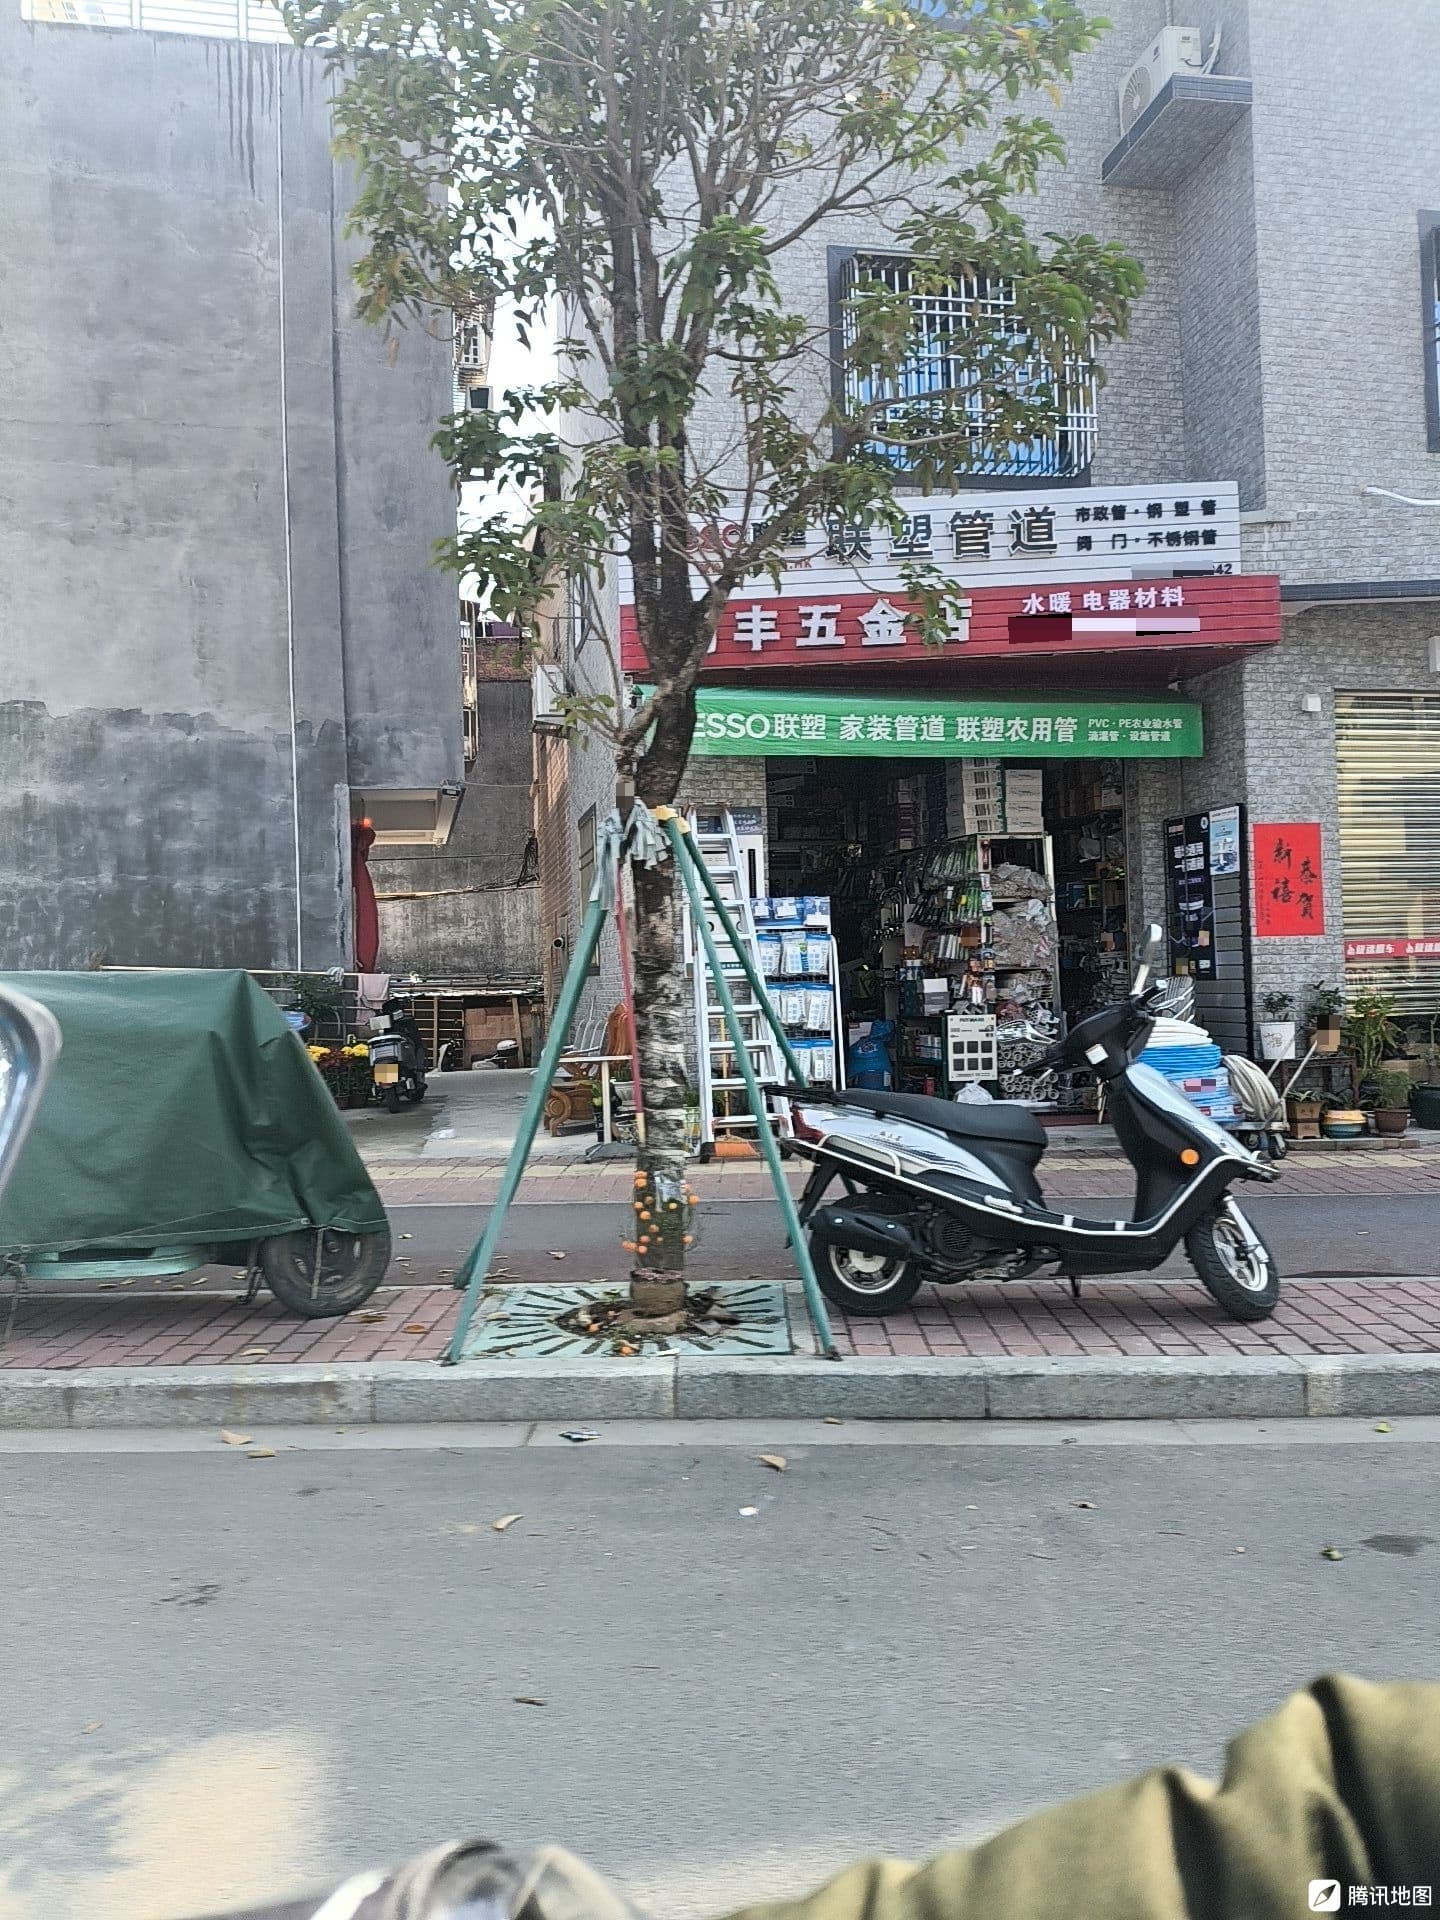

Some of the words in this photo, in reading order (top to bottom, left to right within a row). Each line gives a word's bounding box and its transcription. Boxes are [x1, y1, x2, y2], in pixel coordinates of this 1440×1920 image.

[825, 505, 1058, 564] 联塑管道
[707, 593, 973, 652] 丰五金店
[1022, 592, 1072, 615] 水暖
[1083, 586, 1186, 611] 电器材料
[839, 714, 946, 742] 家装管道
[956, 716, 1078, 743] 联塑农用管
